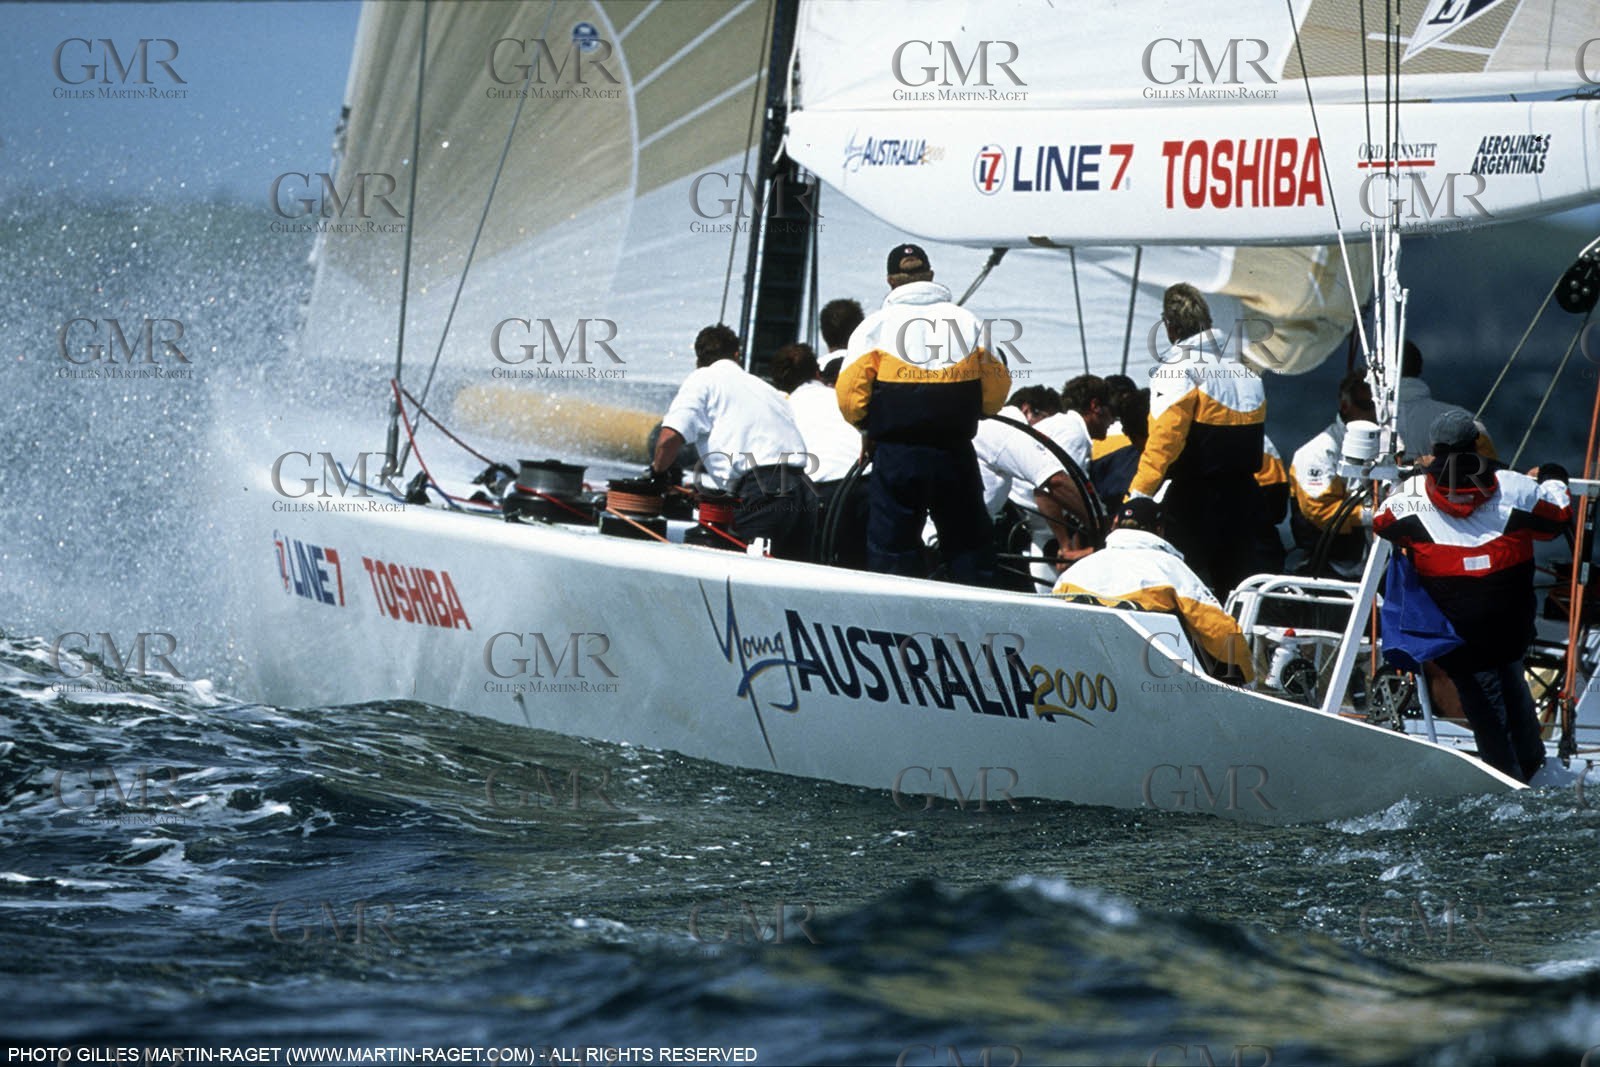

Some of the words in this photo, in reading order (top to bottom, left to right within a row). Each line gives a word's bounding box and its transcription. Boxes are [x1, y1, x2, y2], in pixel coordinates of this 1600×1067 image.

[1161, 137, 1325, 209] TOSHIBA
[1469, 154, 1547, 175] ARGENTINAS
[1477, 134, 1552, 155] AEROLINEAS
[362, 556, 473, 630] TOSHIBA
[784, 608, 1056, 723] AUSTRALIA
[1030, 664, 1118, 728] 2000
